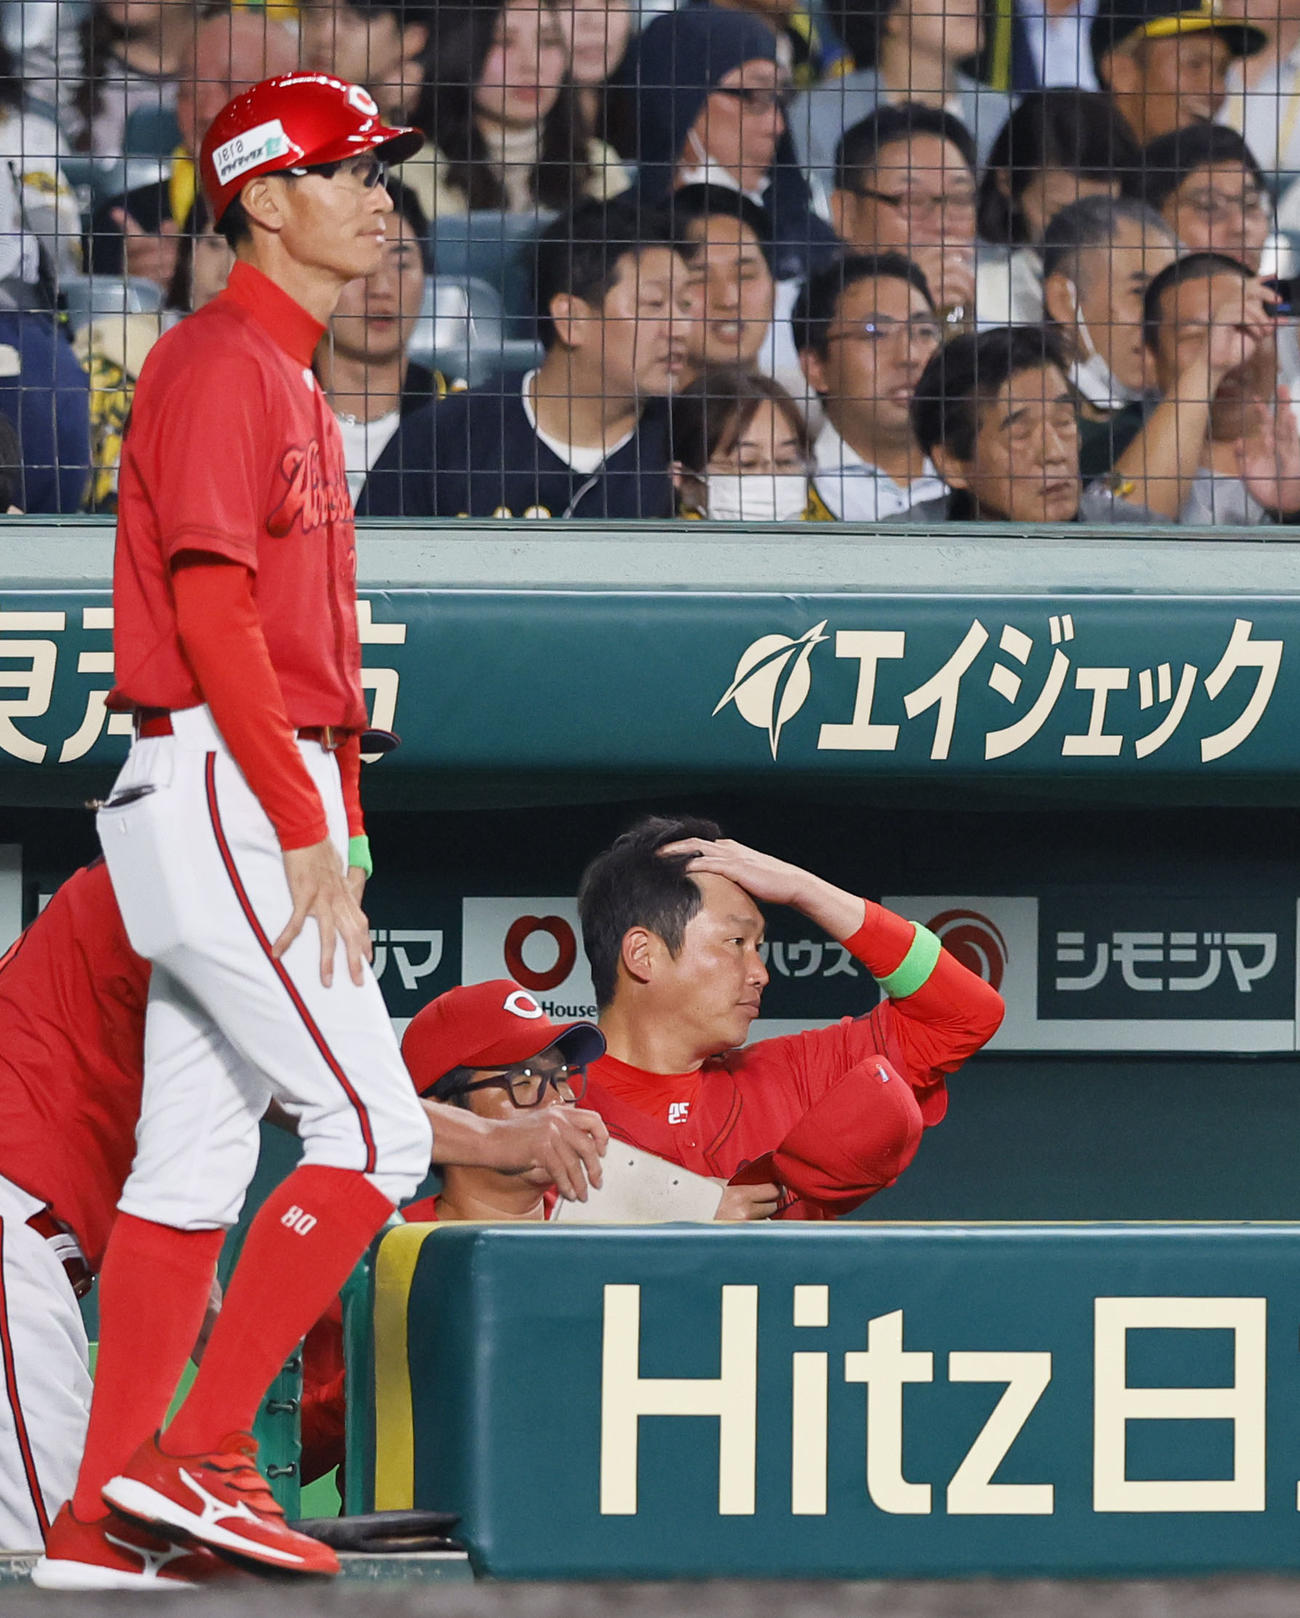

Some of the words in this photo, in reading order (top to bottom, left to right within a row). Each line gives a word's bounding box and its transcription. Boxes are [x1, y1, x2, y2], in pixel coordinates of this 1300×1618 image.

[817, 614, 1285, 763] エイジェック
[1055, 931, 1278, 993] シモジマ
[540, 1001, 598, 1019] House
[668, 1102, 690, 1125] 25
[280, 1205, 318, 1236] 80
[600, 1284, 1300, 1515] Hitz日
